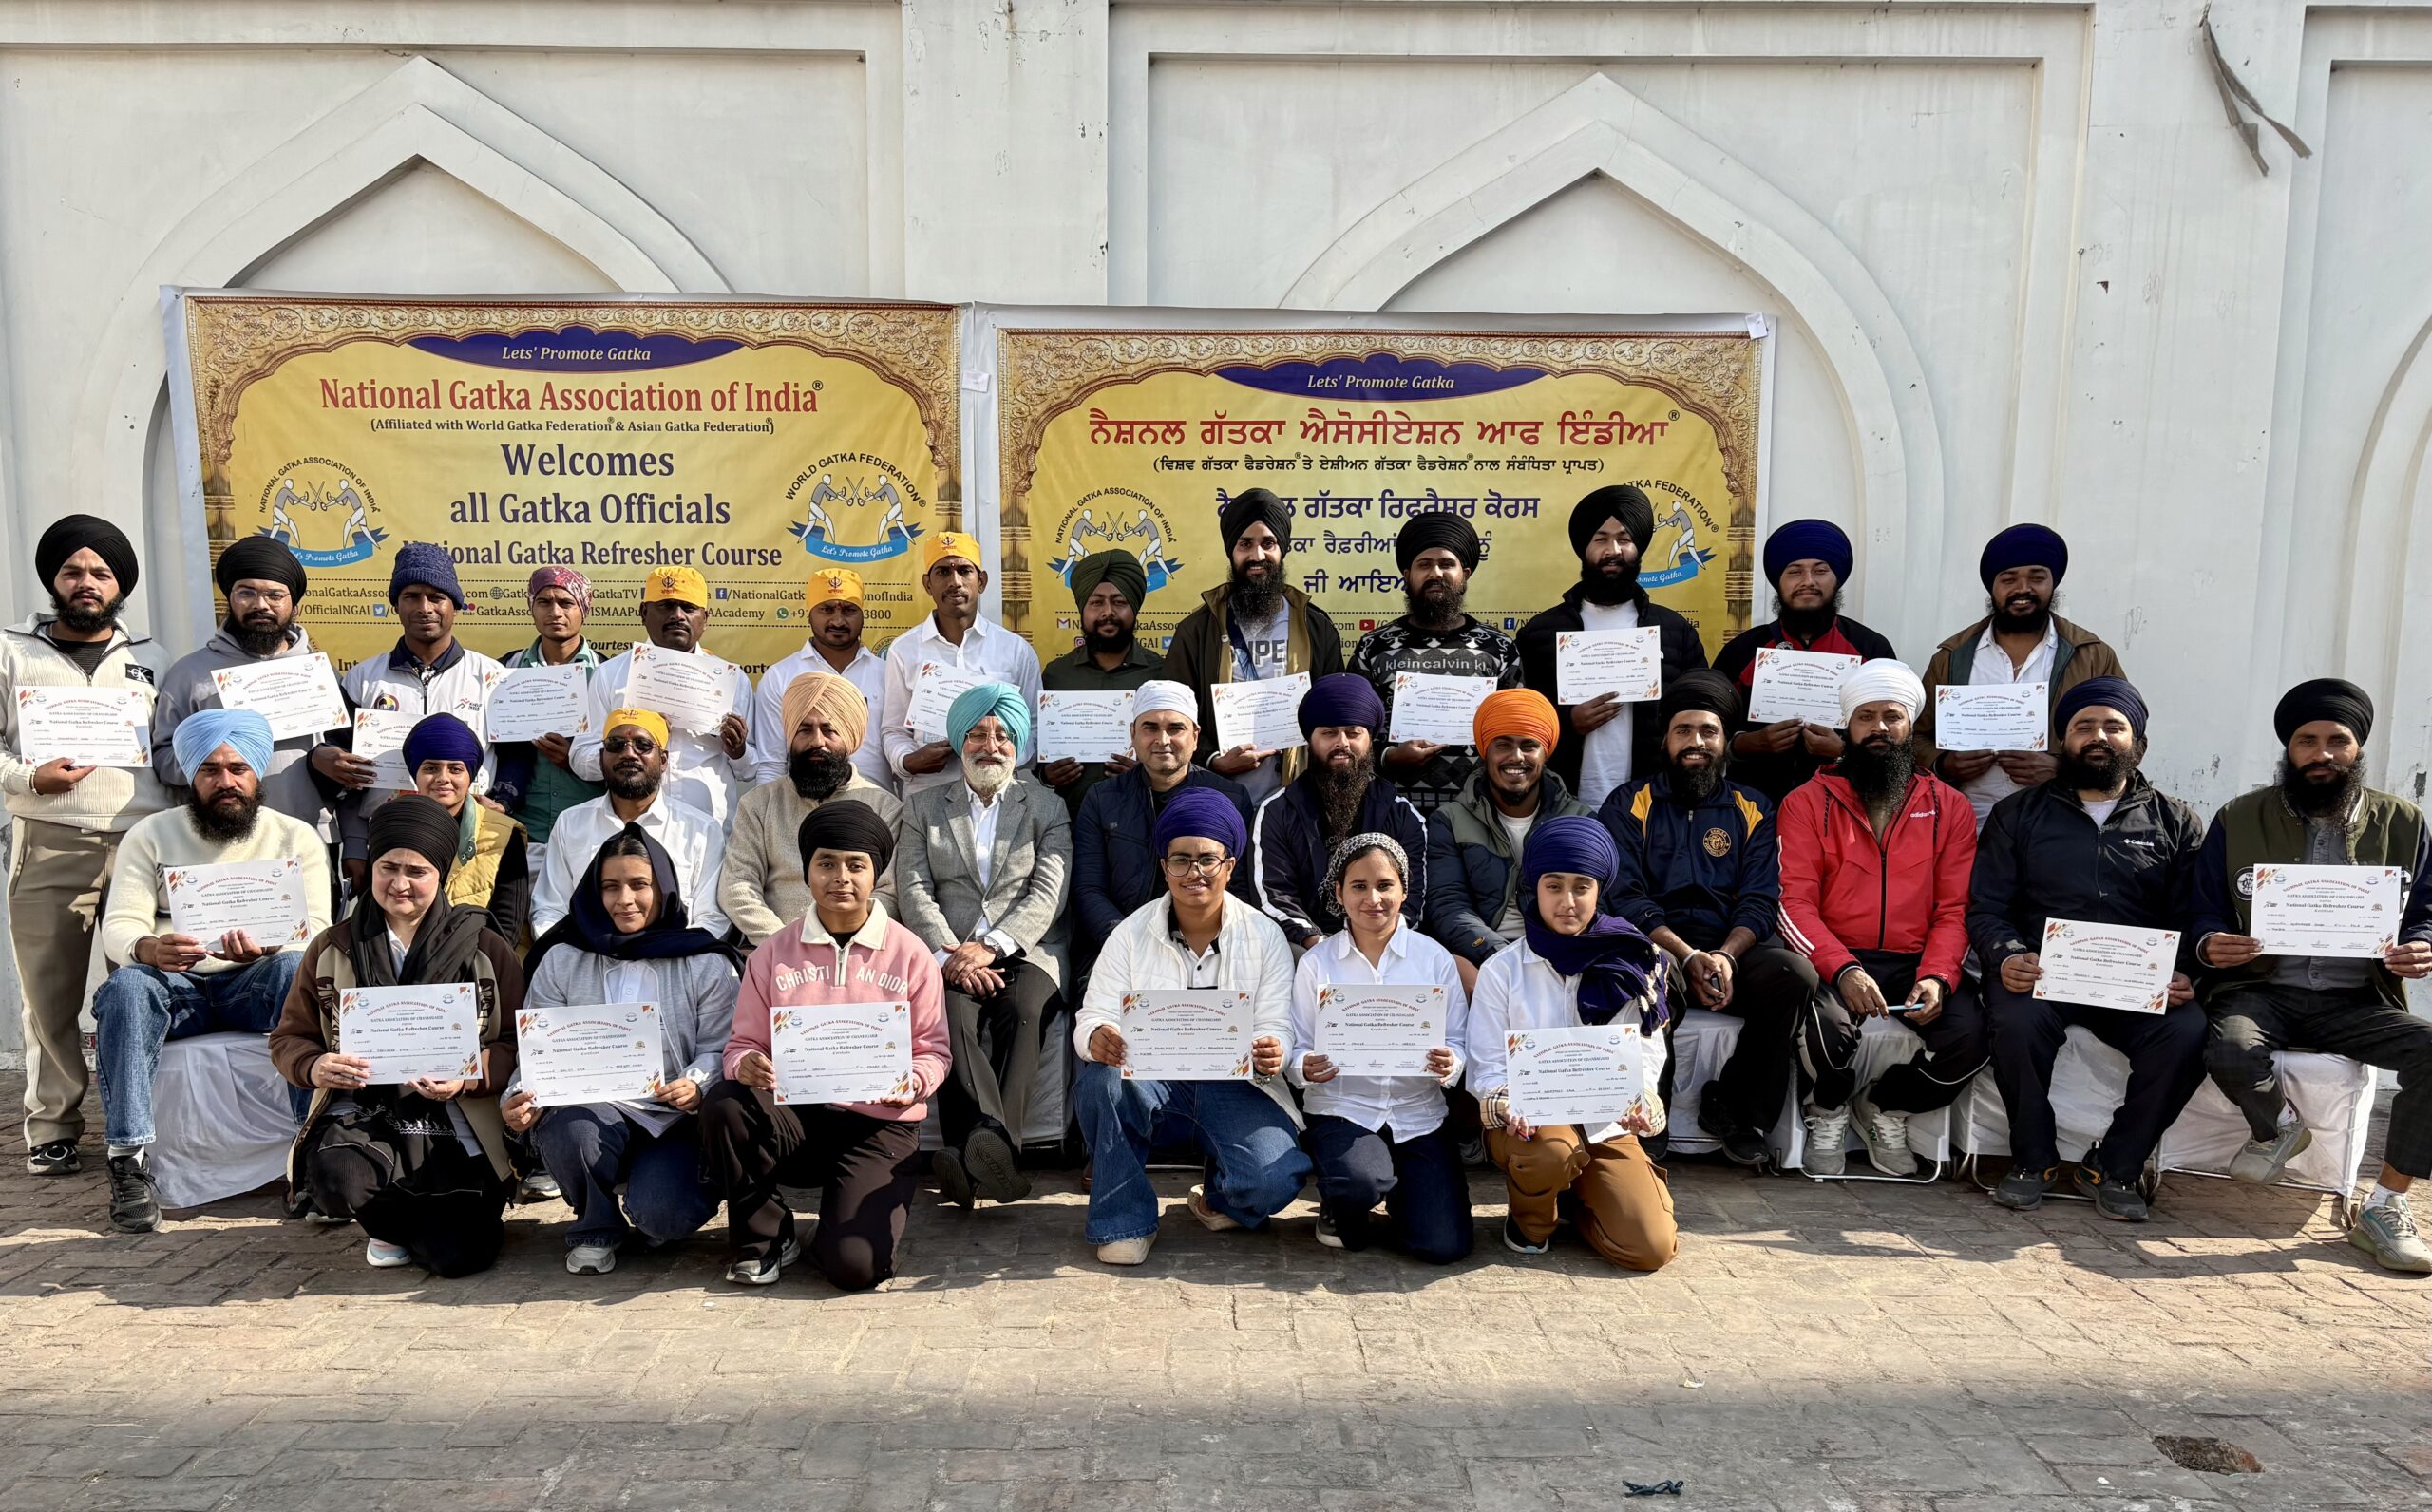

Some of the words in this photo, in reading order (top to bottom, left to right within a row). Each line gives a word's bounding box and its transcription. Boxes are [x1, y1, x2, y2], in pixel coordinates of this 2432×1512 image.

[502, 346, 537, 361] Lets'
[540, 347, 604, 362] Promote
[607, 348, 652, 362] Gatka
[1307, 374, 1343, 389] Lets'
[1345, 375, 1408, 390] Promote
[1412, 376, 1455, 390] Gatka
[321, 379, 440, 410] National
[449, 380, 531, 411] Gatka
[540, 381, 704, 412] Association
[711, 380, 738, 412] of
[370, 418, 431, 432] (Affiliated
[435, 419, 463, 431] with
[466, 419, 504, 431] World
[507, 420, 542, 432] Gatka
[616, 422, 624, 432] &
[628, 421, 661, 433] Asian
[665, 421, 700, 433] Gatka
[1090, 408, 1187, 444] ਨੈਸ਼ਨਲ
[1200, 410, 1286, 445] ਗੱਤਕਾ
[1300, 408, 1464, 446] ਐਸੋਸੀਏਸ਼ਨ
[1477, 421, 1544, 445] ਆਫ
[501, 444, 674, 477] Welcomes
[1202, 455, 1239, 472] ਗੱਤਕਾ
[1302, 455, 1313, 472] ਤੇ
[1374, 456, 1411, 472] ਗੱਤਕਾ
[1474, 460, 1500, 472] ਨਾਲ
[258, 475, 280, 514] NATIONAL
[278, 459, 303, 477] GATKA
[303, 456, 357, 481] ASSOCIATION
[355, 477, 367, 489] OF
[785, 463, 818, 501] WORLD
[818, 452, 857, 469] GATKA
[450, 492, 487, 524] all
[499, 492, 591, 525] Gatka
[600, 493, 732, 525] Officials
[1055, 505, 1079, 544] NATIONAL
[1077, 489, 1103, 507] GATKA
[1103, 486, 1156, 510] ASSOCIATION
[1154, 507, 1165, 520] OF
[1303, 489, 1374, 519] ਗੱਤਕਾ
[1483, 488, 1541, 519] ਕੋਰਸ
[305, 553, 335, 562] Promote
[336, 550, 359, 562] Gatka
[506, 540, 576, 565] Gatka
[582, 541, 696, 566] Refresher
[702, 541, 783, 566] Course
[821, 545, 837, 556] Let's
[838, 548, 869, 557] Promote
[869, 546, 893, 558] Gatka
[1303, 569, 1329, 593] ਜੀ
[1659, 570, 1683, 583] Gatka
[878, 972, 908, 996] DIOR
